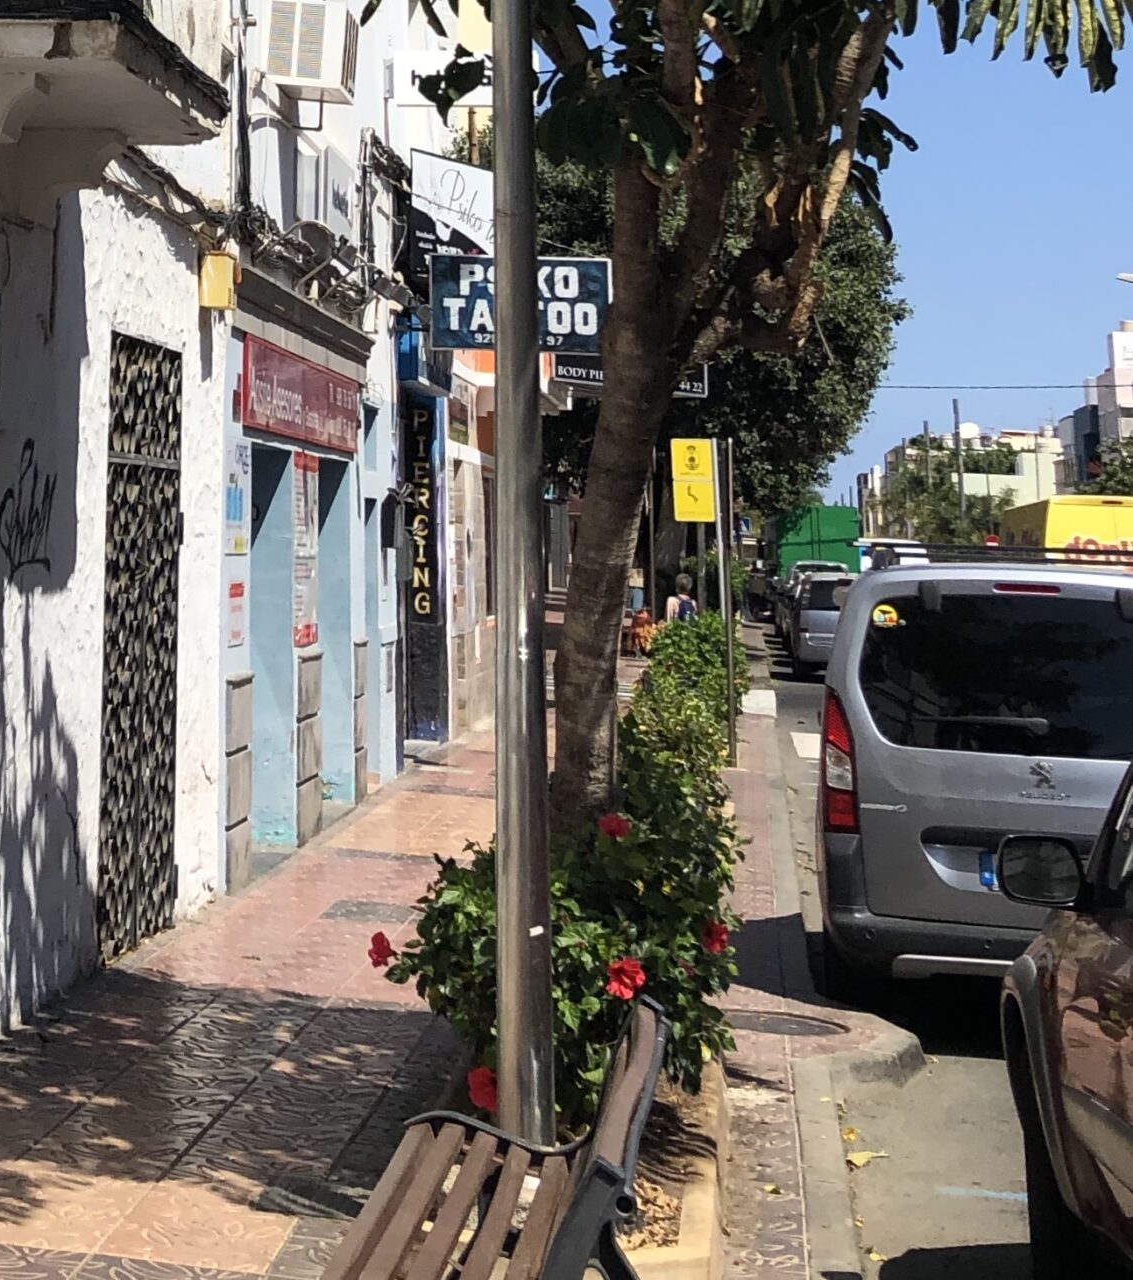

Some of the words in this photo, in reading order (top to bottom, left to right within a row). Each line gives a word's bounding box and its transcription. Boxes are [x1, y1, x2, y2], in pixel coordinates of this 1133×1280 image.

[459, 263, 579, 299] PSKO
[443, 297, 598, 336] TAOO
[557, 366, 587, 378] BODY
[678, 381, 690, 391] 44
[692, 383, 703, 392] 22
[412, 409, 431, 614] PIERCING
